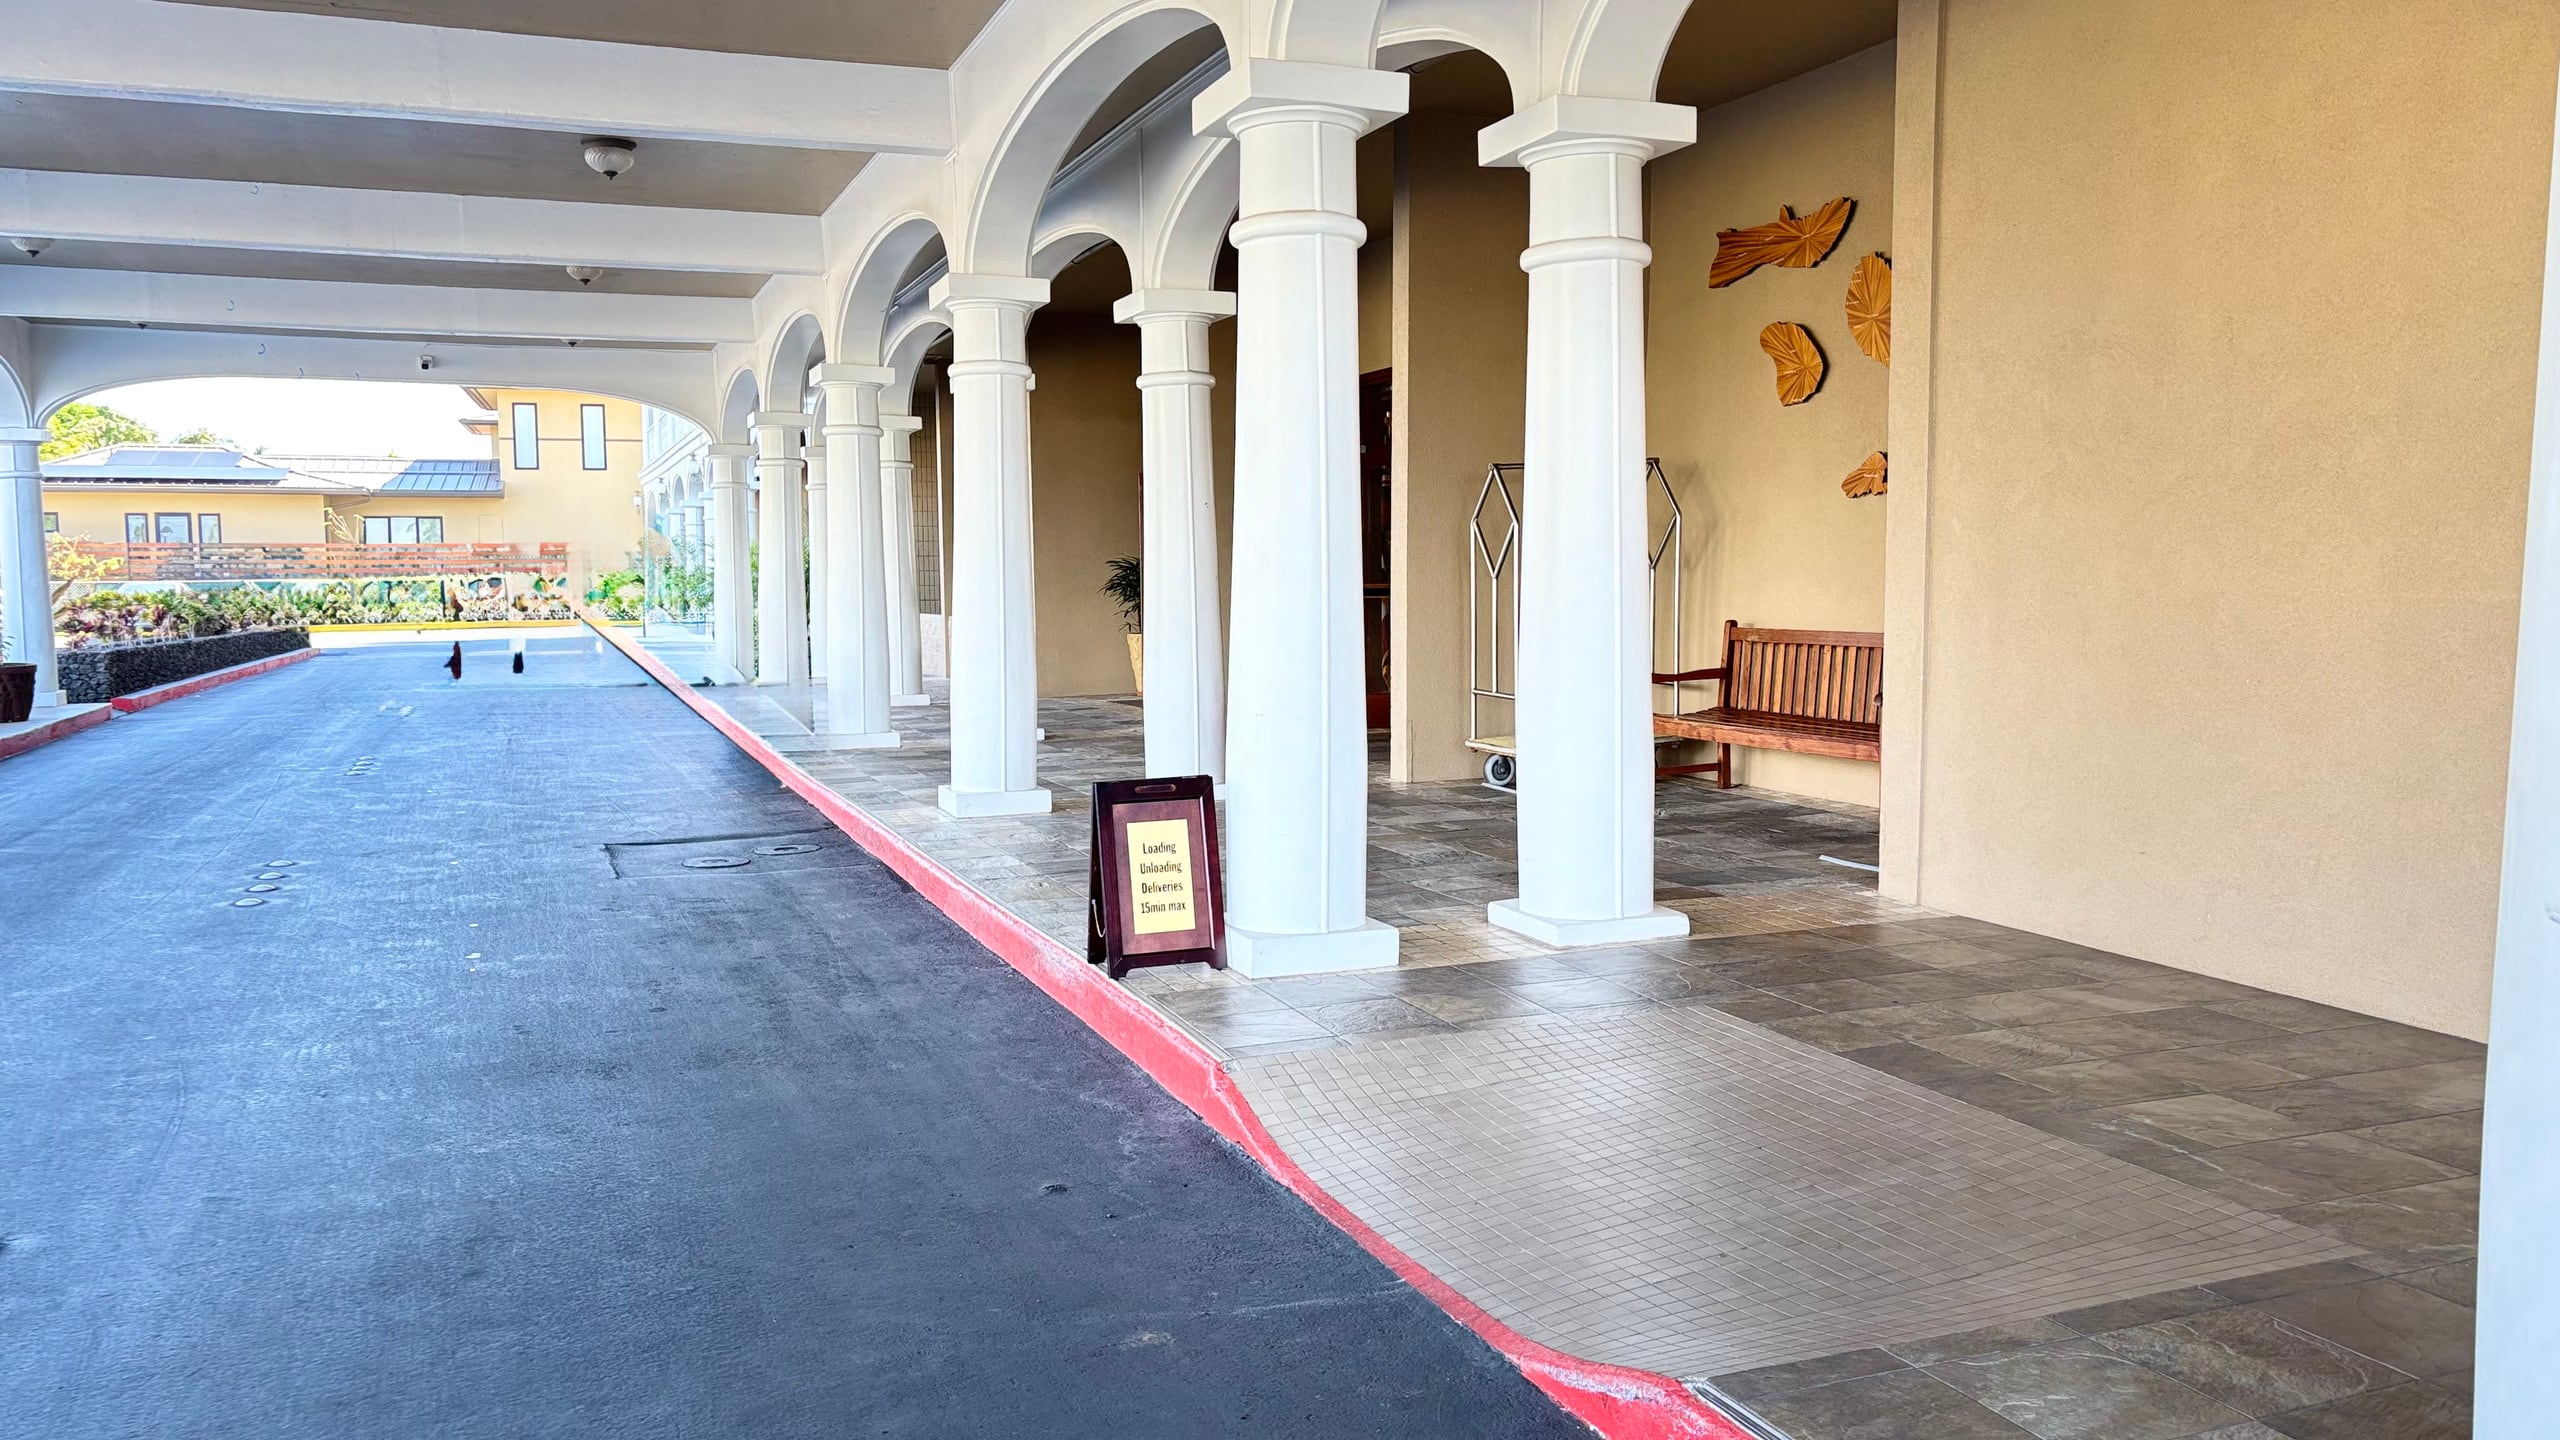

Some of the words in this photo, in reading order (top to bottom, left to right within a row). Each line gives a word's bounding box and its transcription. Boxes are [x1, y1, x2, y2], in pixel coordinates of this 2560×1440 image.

[1142, 842, 1177, 855] Loading
[1140, 861, 1182, 875] Unloading
[1141, 880, 1184, 894] Deliveries
[1141, 901, 1166, 914] 15min
[1168, 902, 1186, 912] max
